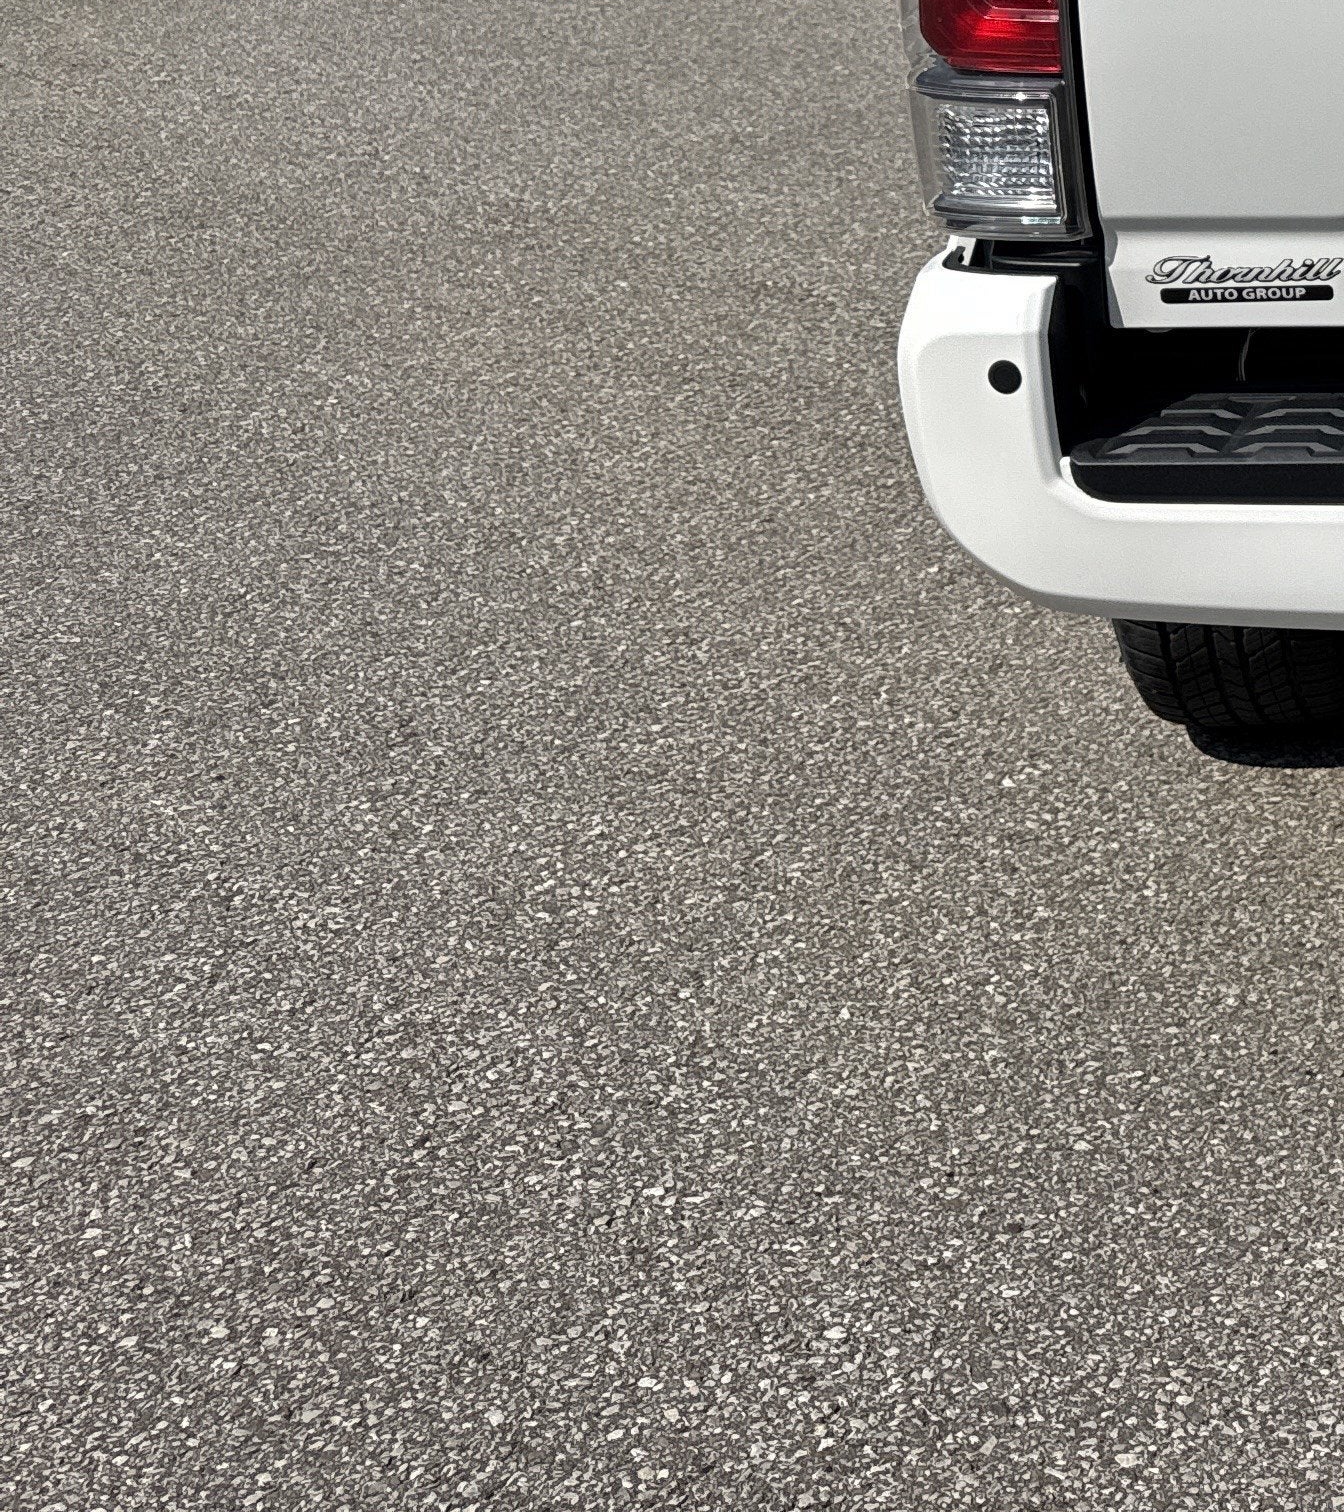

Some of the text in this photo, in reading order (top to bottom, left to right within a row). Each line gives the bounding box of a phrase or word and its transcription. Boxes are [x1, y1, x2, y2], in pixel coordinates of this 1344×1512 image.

[1145, 254, 1344, 285] Thornhill
[1188, 287, 1307, 302] AUTO GROUP
